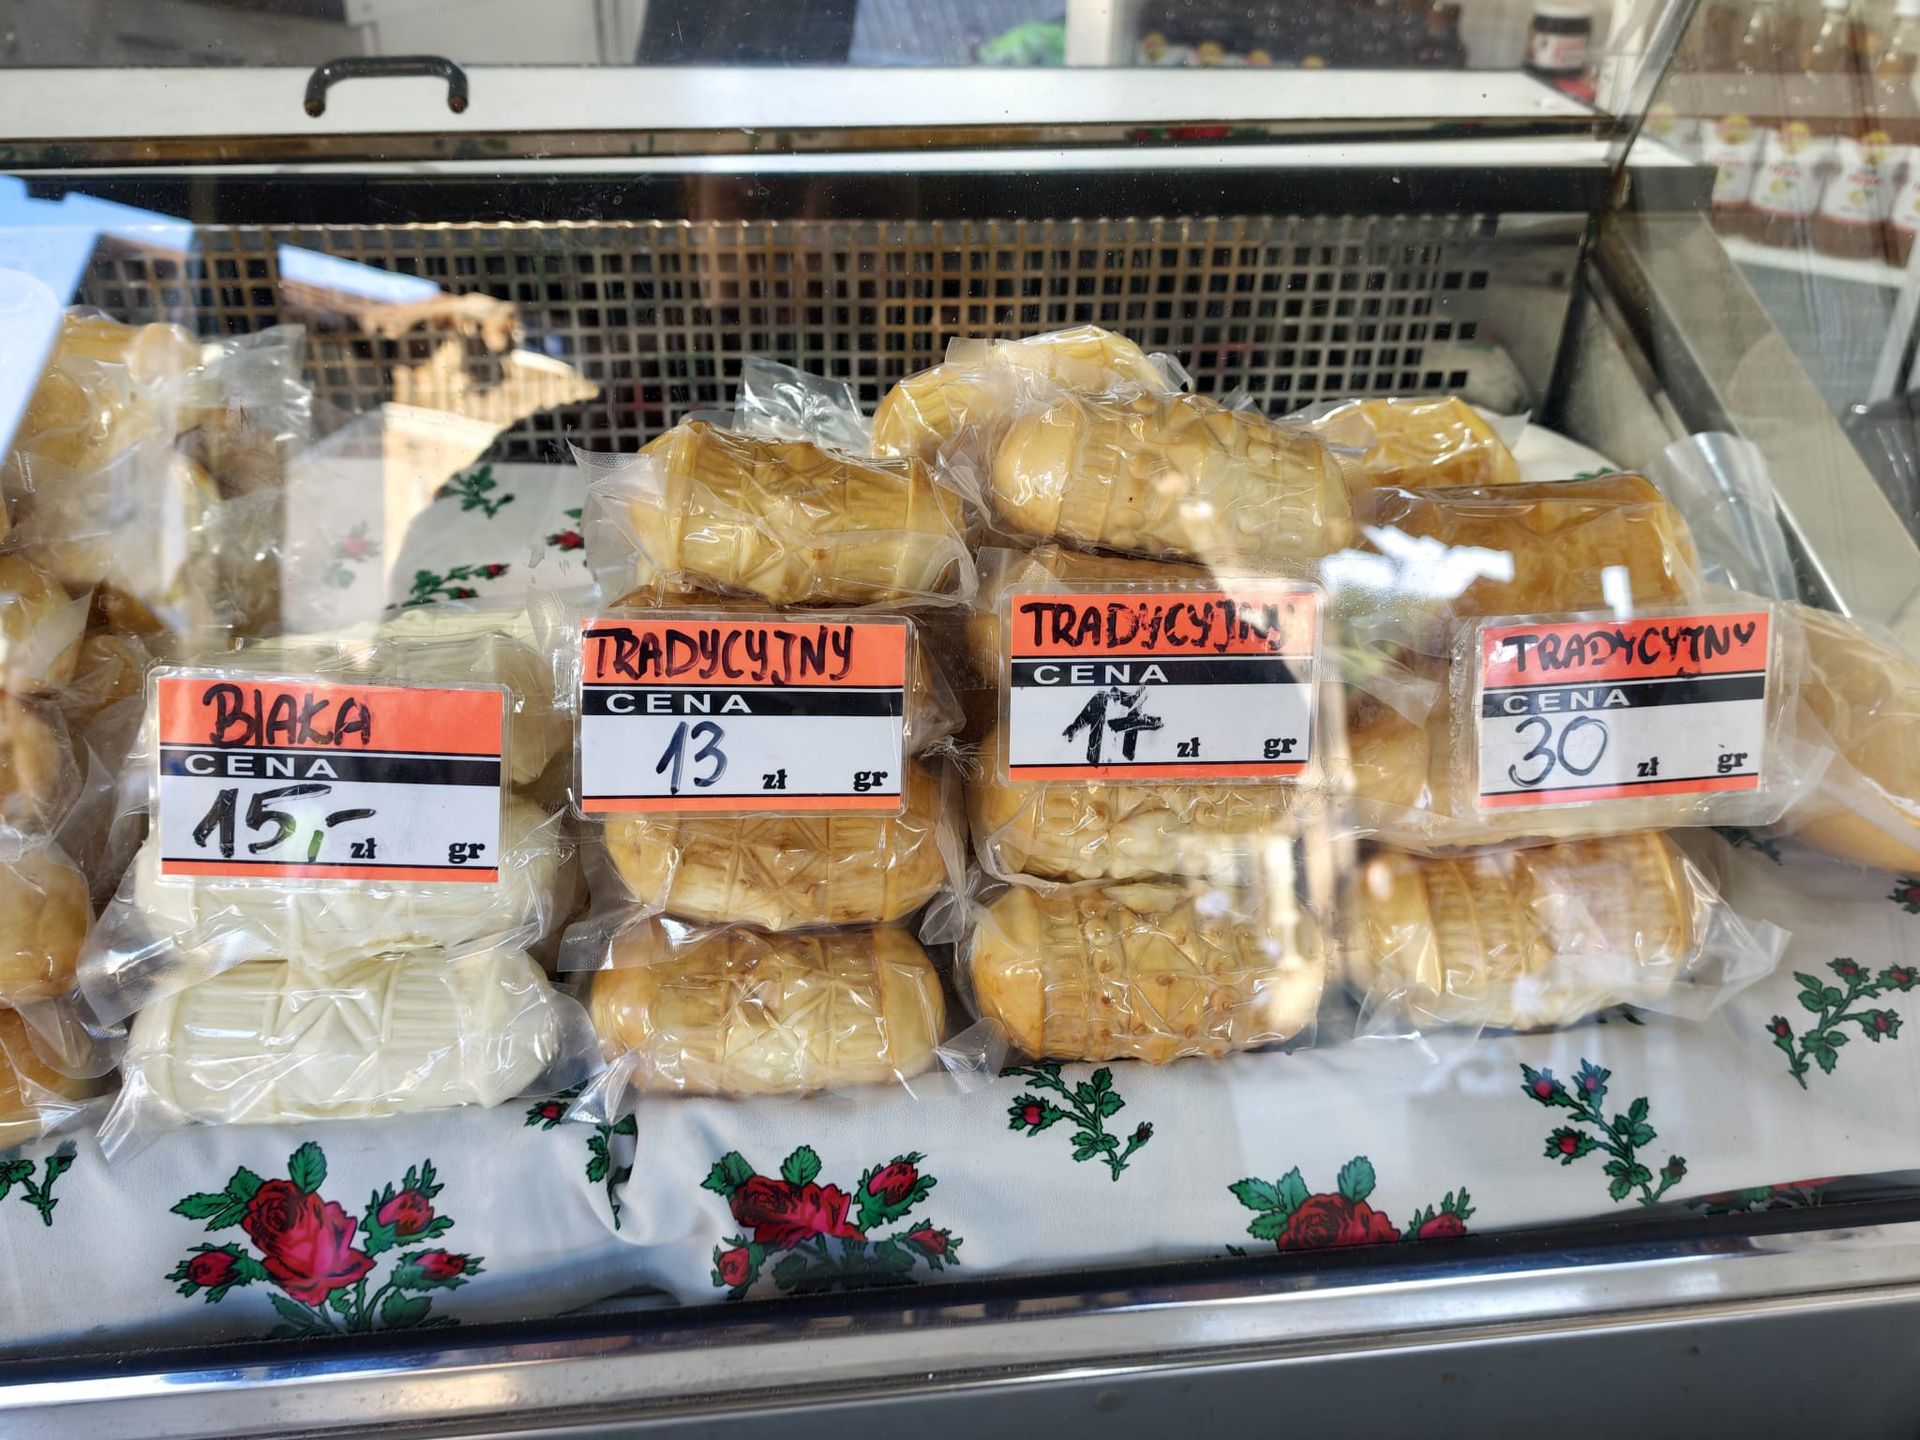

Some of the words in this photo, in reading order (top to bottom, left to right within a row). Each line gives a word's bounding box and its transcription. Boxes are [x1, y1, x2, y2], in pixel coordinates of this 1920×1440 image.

[582, 624, 854, 685] TRADYCYJNY
[1033, 664, 1169, 684] CENA
[605, 693, 752, 714] CENA
[1503, 688, 1631, 714] CENA
[655, 720, 728, 795] 13
[762, 768, 787, 790] zł
[853, 769, 889, 791] gr
[1177, 736, 1201, 758] zł
[1263, 736, 1298, 760] gr
[1508, 715, 1609, 788] 30
[1637, 757, 1659, 778] zł
[1716, 751, 1748, 774] gr
[184, 753, 338, 779] CENA
[350, 837, 377, 860] zł
[448, 841, 486, 864] gr
